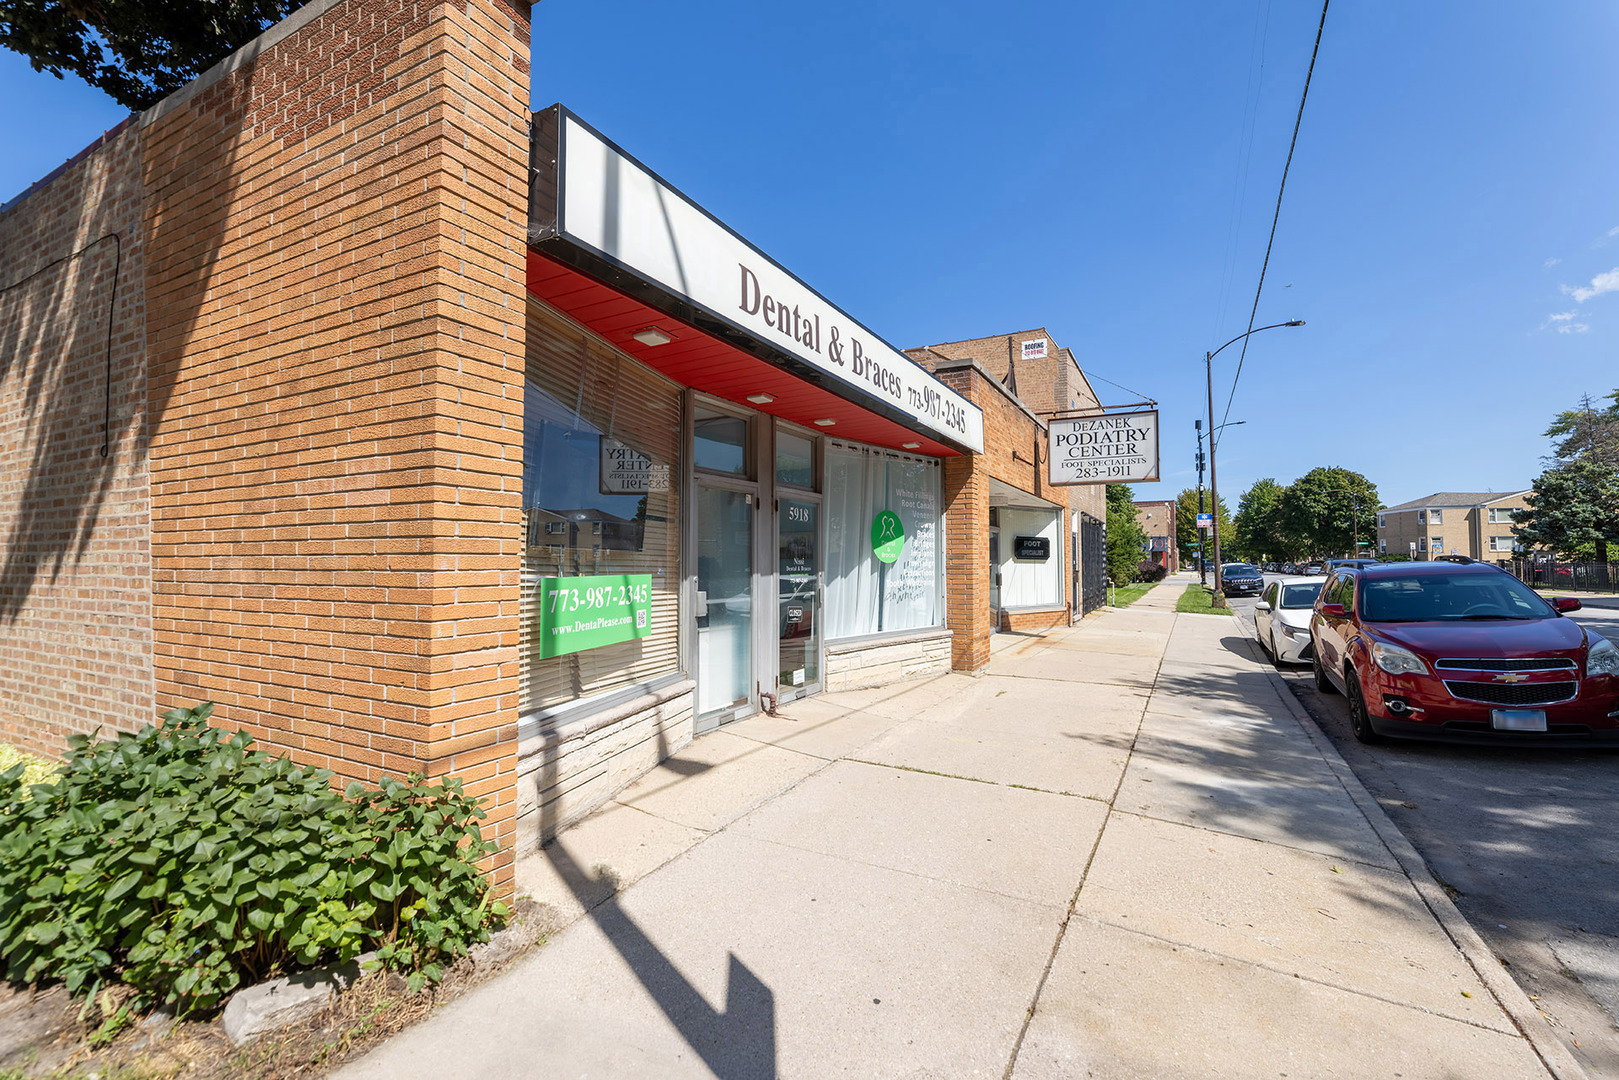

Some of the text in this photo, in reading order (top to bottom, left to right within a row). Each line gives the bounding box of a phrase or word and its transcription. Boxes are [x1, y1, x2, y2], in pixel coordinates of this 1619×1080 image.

[739, 263, 821, 354] Dental
[828, 326, 844, 367] &
[850, 337, 901, 399] Braces
[1056, 428, 1150, 446] PODIATRY
[1069, 443, 1138, 458] CENTER
[1061, 458, 1147, 470] FOOT SPECIALISTS
[1076, 466, 1130, 479] 283-1911
[896, 488, 915, 499] White
[901, 499, 915, 509] Root
[789, 507, 809, 522] 5918
[548, 584, 648, 613] 773-987-2345
[552, 616, 633, 636] www.DentaPlease.com
